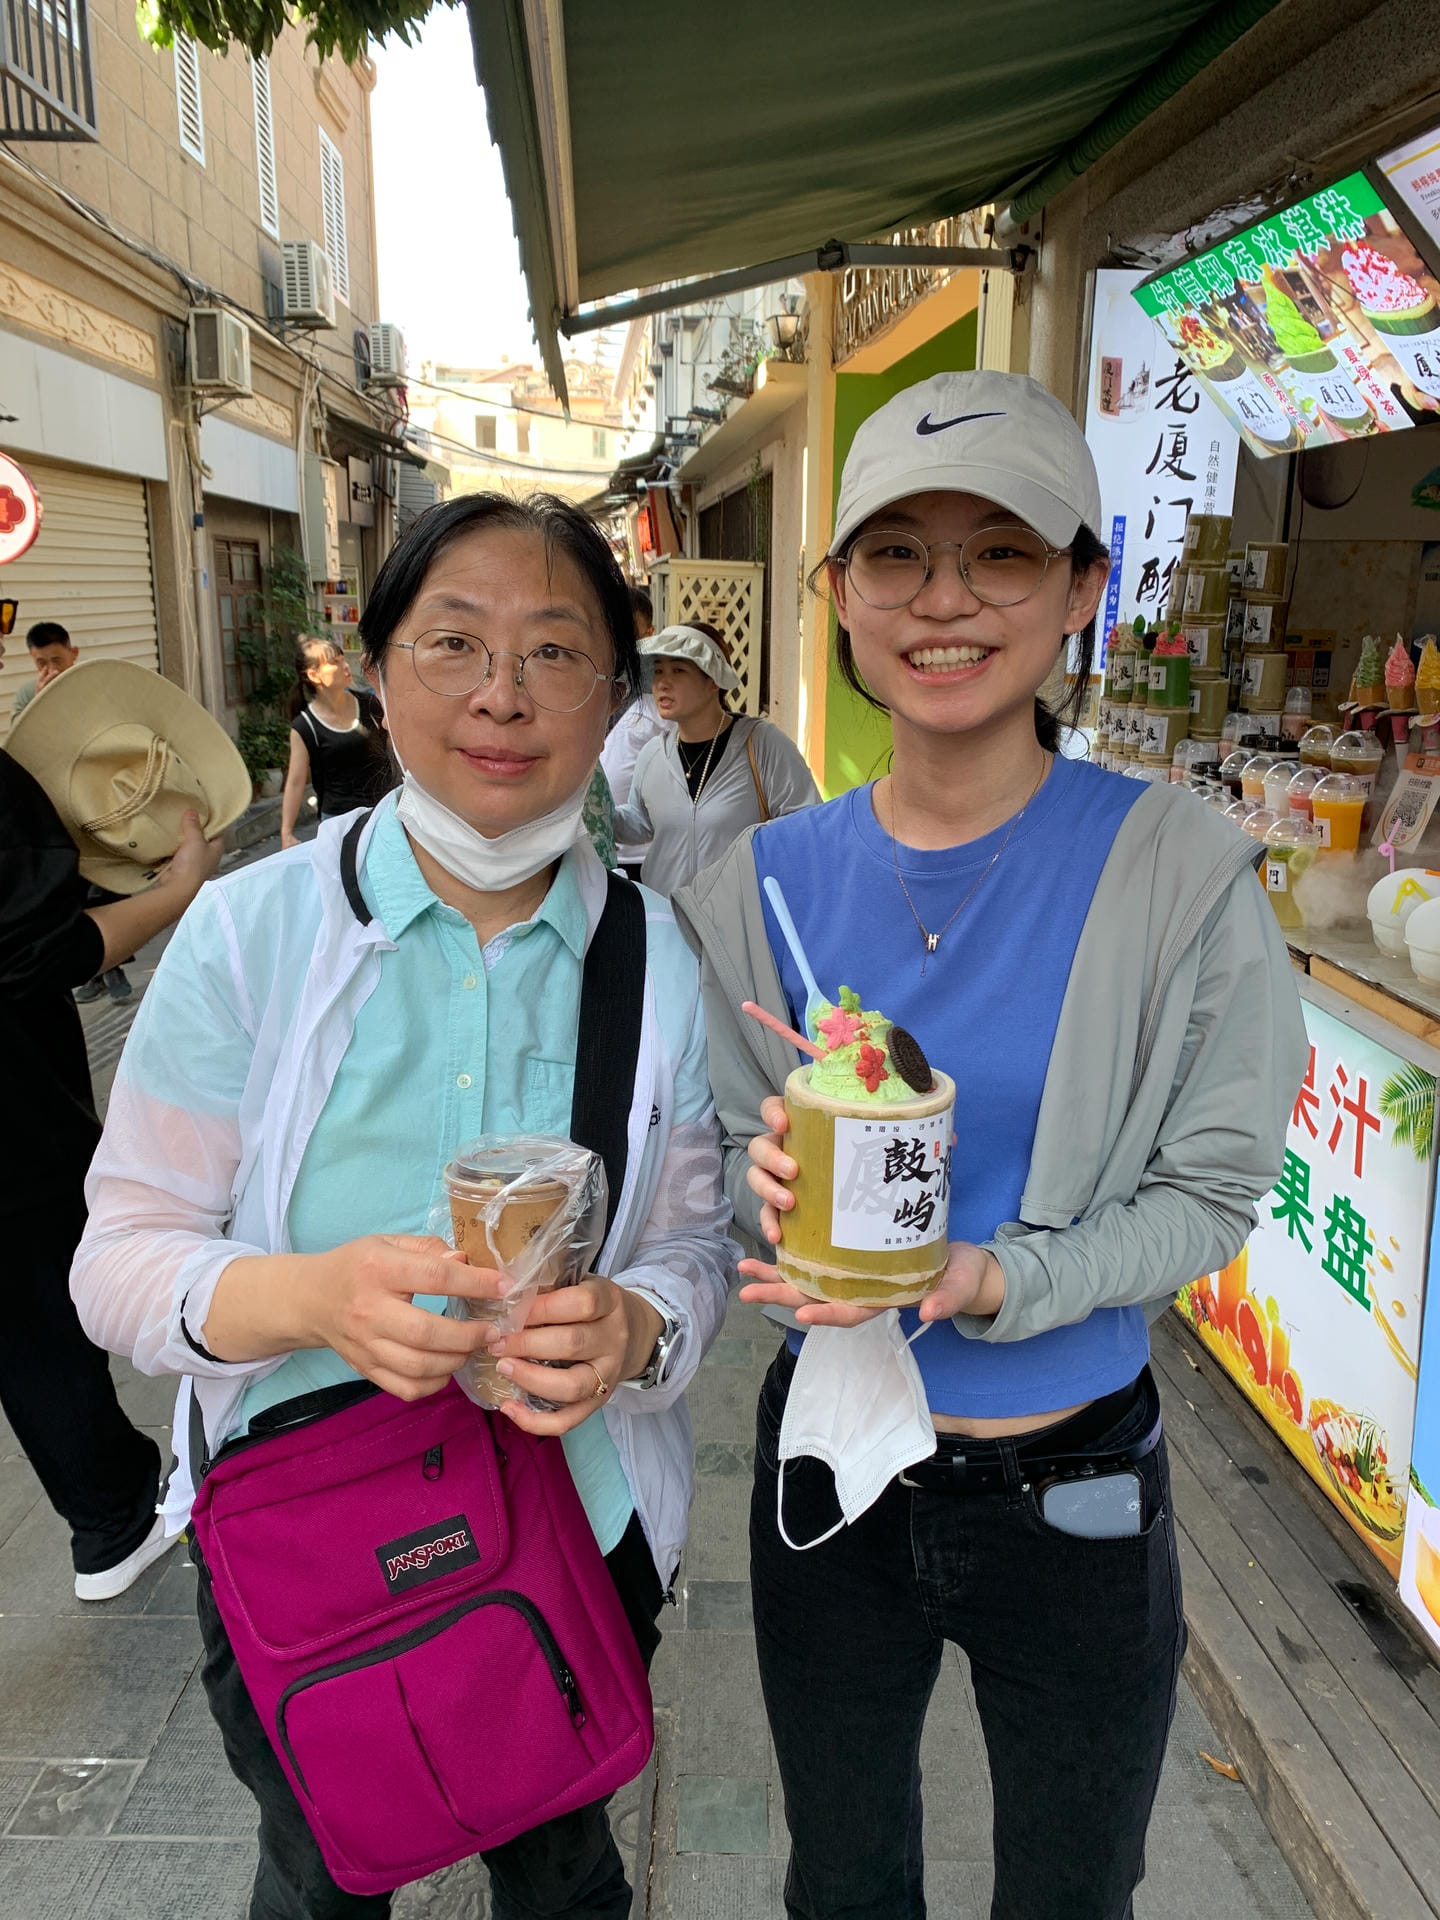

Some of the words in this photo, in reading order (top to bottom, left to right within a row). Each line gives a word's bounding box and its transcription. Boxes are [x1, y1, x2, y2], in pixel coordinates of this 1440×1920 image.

[1150, 189, 1366, 317] 竹筒椰冻冰淇淋
[1413, 350, 1440, 378] 厦
[1136, 357, 1199, 622] 老厦门酸
[1253, 1147, 1373, 1312] 果盘
[386, 1530, 466, 1581] JANSPORT
